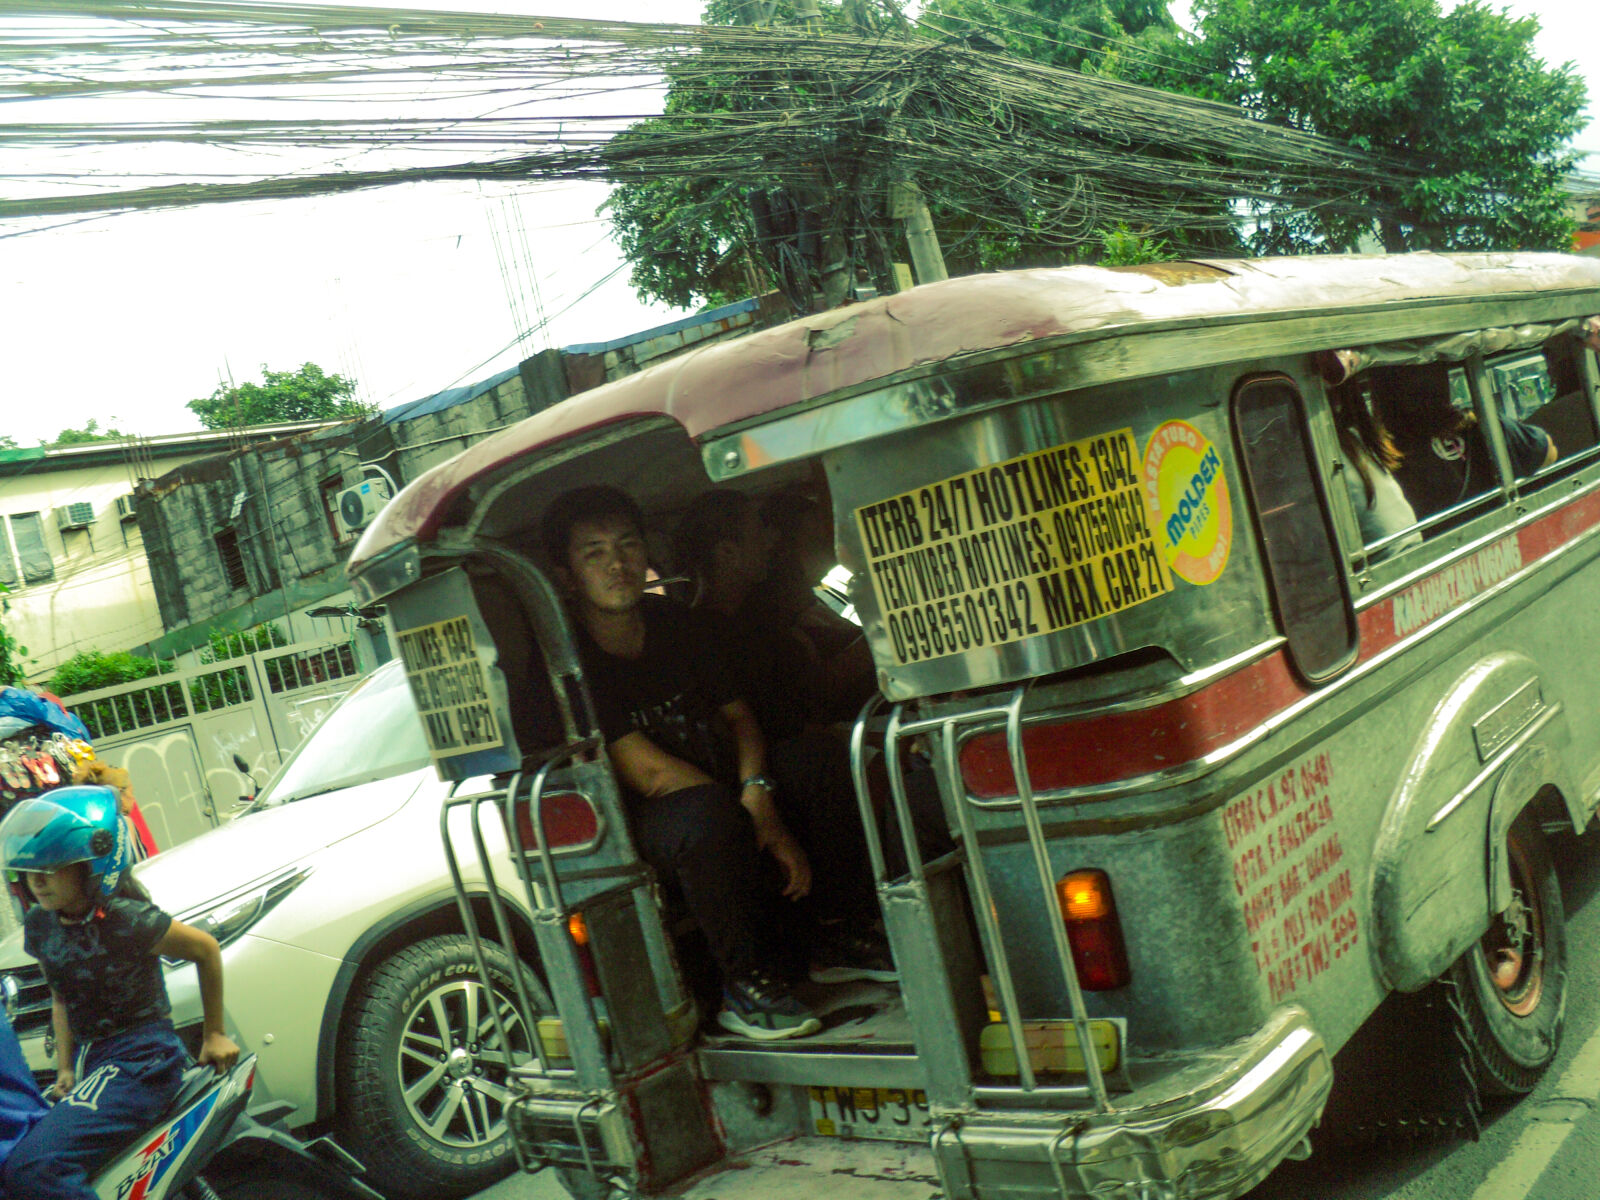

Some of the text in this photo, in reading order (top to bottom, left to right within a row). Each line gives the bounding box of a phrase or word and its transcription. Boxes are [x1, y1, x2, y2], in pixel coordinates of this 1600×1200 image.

[859, 432, 1138, 558] LTFRB 24/7 HOTLINES: 1342
[872, 487, 1153, 611] TEXT/VIBER HOTLINES: 09175501342
[887, 580, 1039, 665] 09985501342
